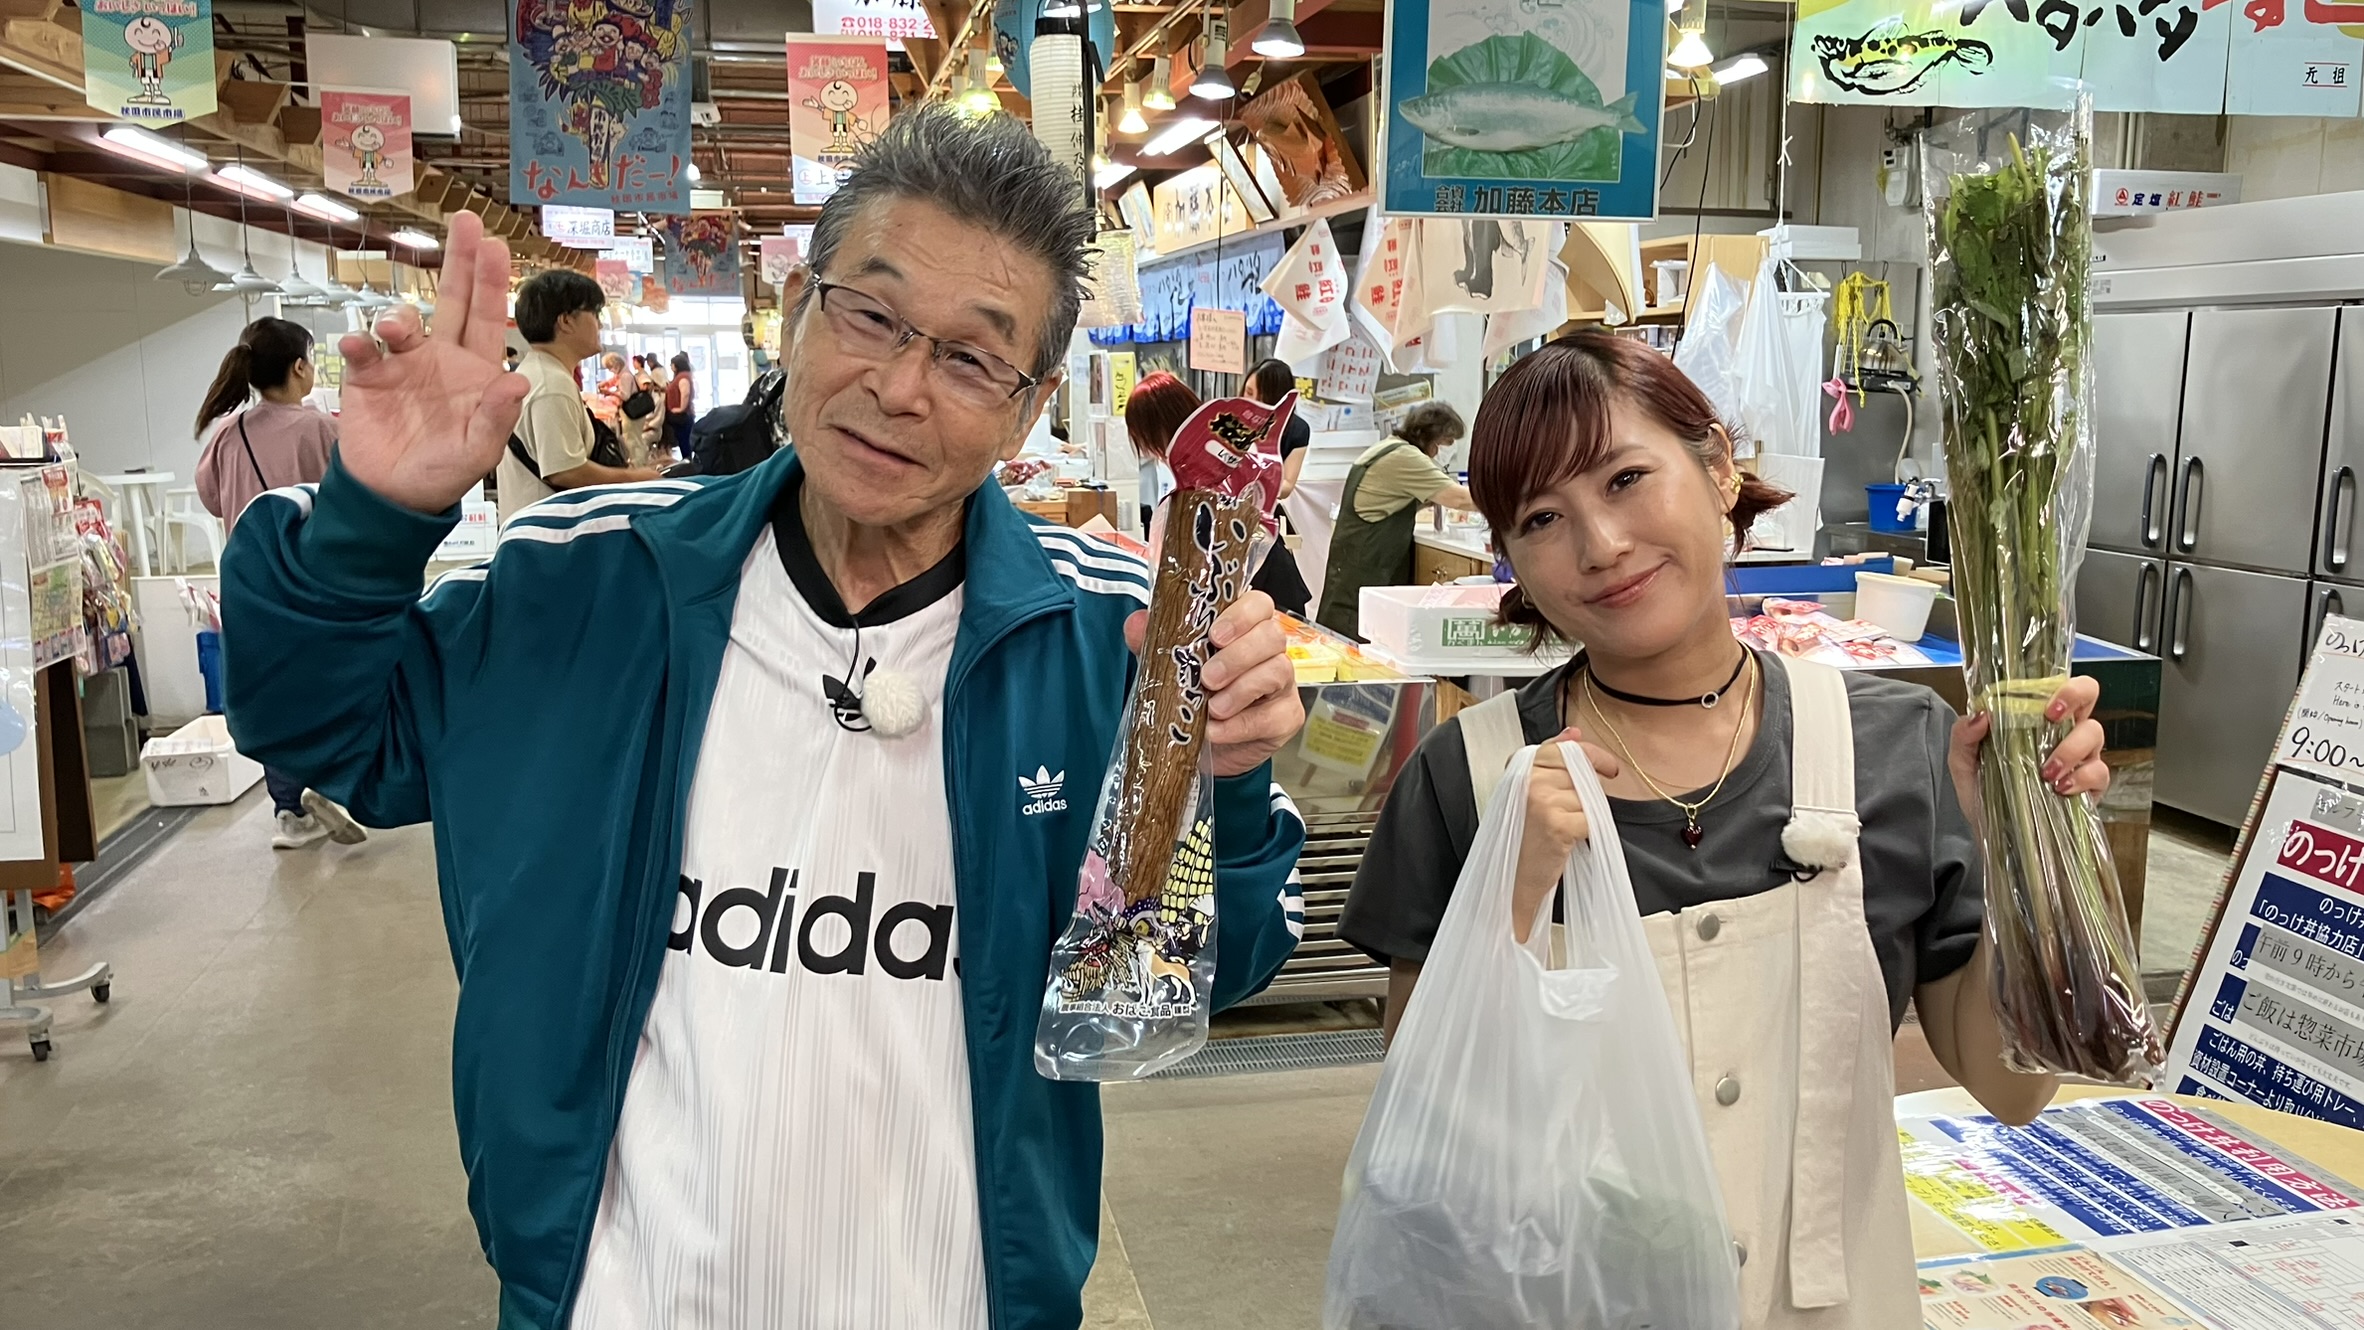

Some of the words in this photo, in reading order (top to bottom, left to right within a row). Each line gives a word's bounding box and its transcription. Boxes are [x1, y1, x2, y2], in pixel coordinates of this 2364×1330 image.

[2303, 65, 2346, 85] 元祖
[1473, 186, 1599, 215] 加藤本店
[1022, 798, 1068, 816] adidas
[667, 866, 961, 982] adida
[2258, 899, 2364, 959] 「のっけ丼協力店」
[2208, 1032, 2357, 1123] ごはん用の丼、持ち運び用トレー、
[2144, 1099, 2351, 1209] のっけ丼利用方法
